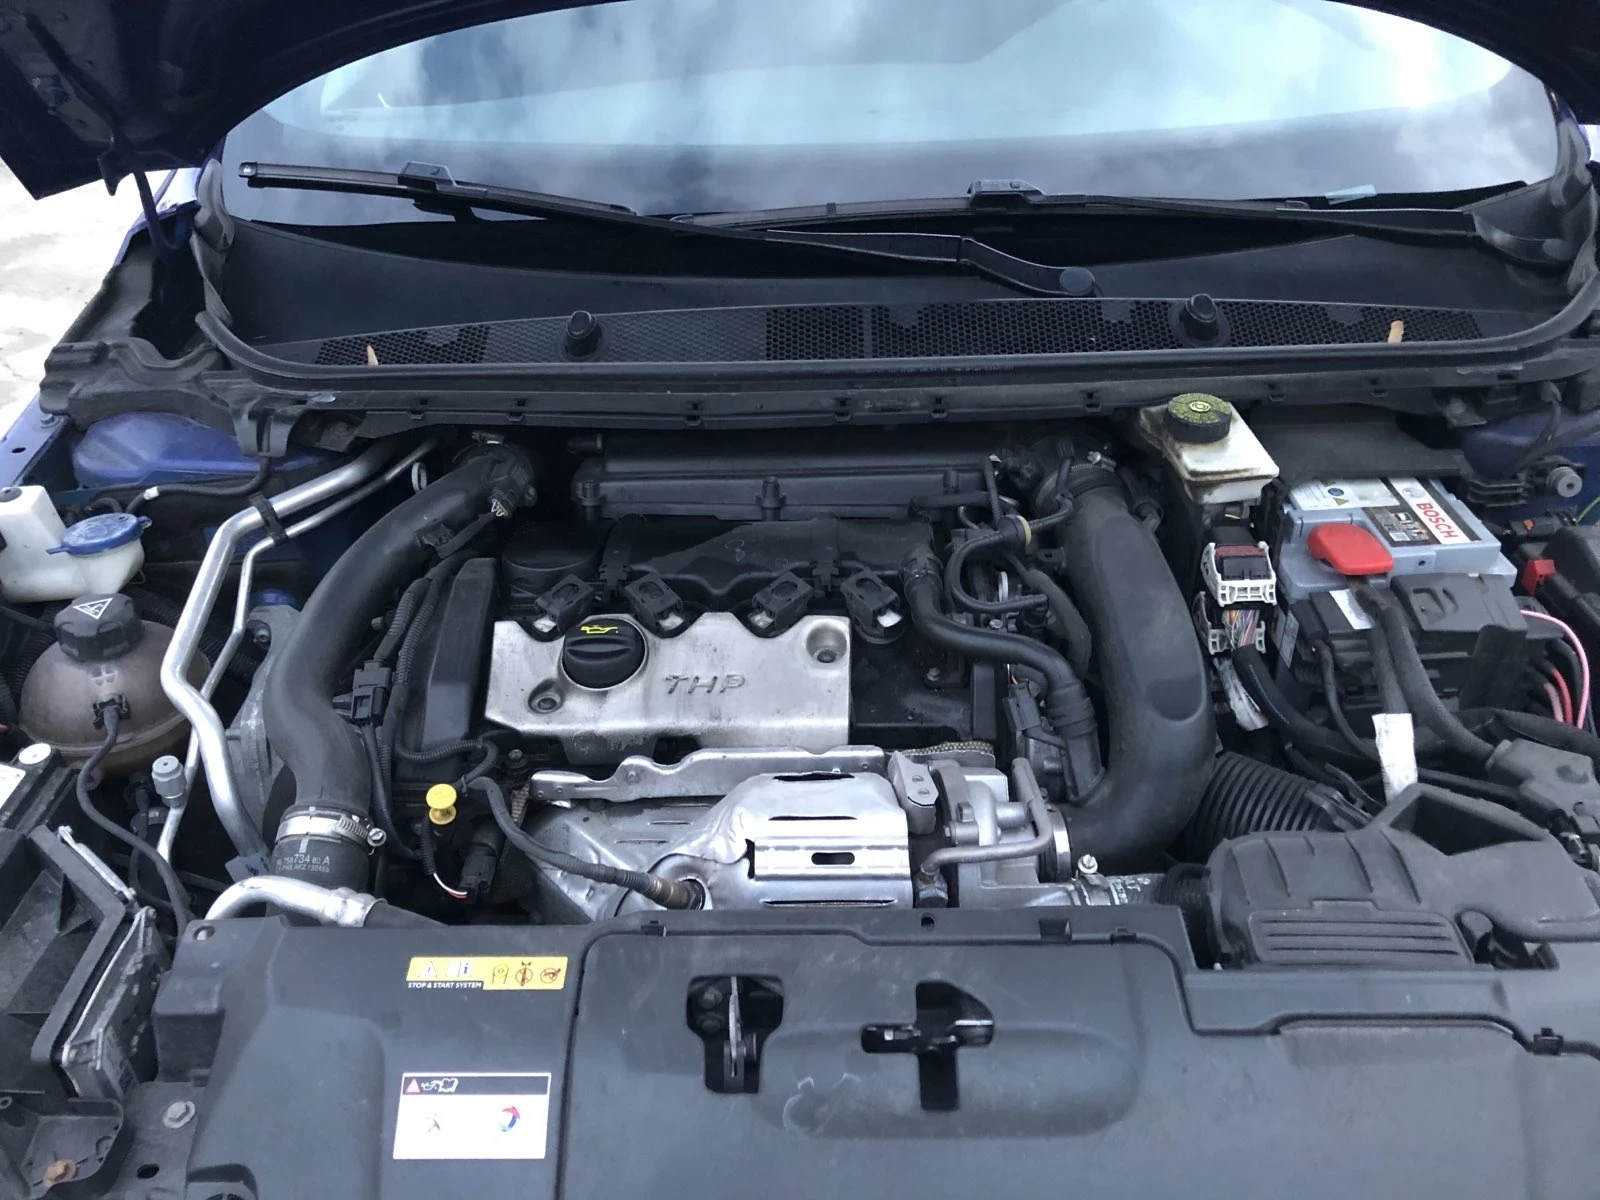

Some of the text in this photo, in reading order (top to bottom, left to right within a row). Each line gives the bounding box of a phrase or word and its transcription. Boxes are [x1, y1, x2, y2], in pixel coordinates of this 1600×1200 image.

[1416, 502, 1458, 539] BOSCH
[664, 674, 746, 694] THP
[322, 855, 331, 866] A
